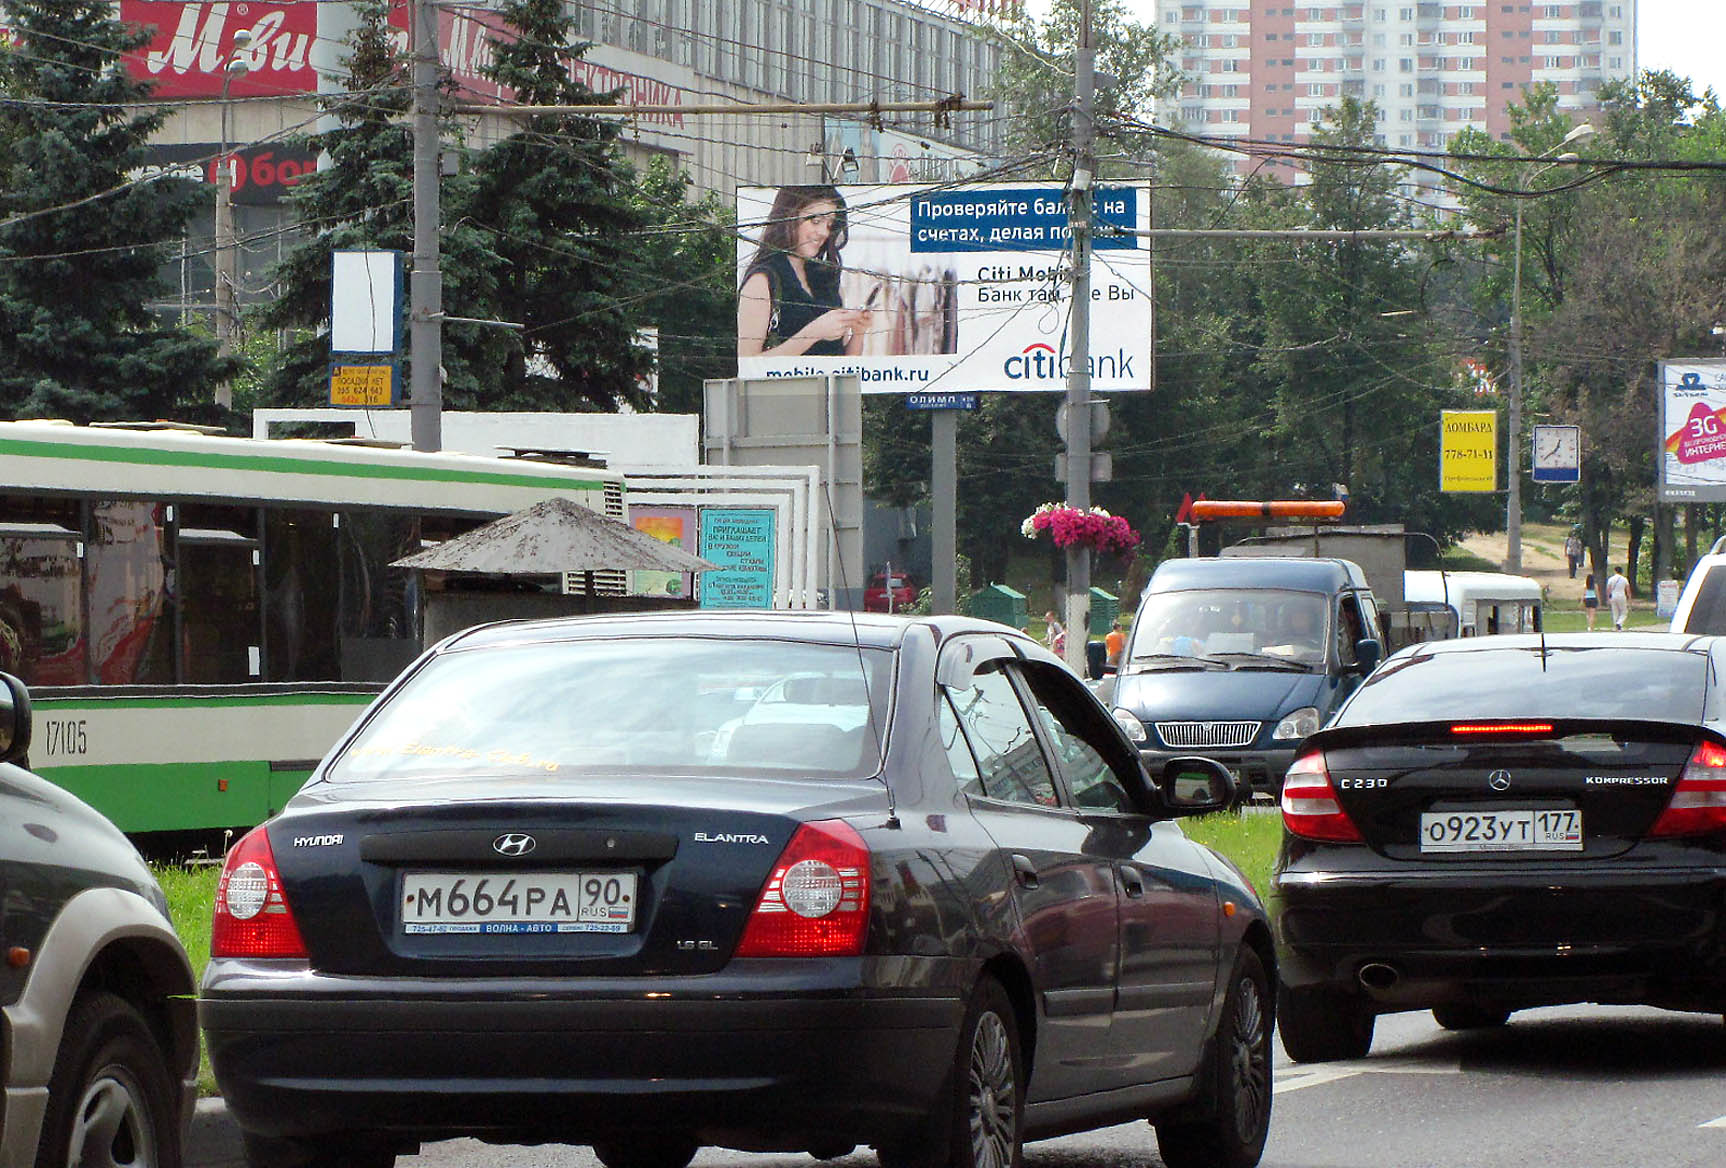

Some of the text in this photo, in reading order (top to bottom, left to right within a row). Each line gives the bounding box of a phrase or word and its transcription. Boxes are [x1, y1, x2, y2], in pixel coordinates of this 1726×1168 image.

[918, 198, 1125, 219] Проверяйте балс на
[918, 227, 984, 242] счетах,
[989, 227, 1044, 243] делая
[978, 266, 1011, 282] Citi
[978, 288, 1022, 303] Банк
[1108, 285, 1135, 301] Вы
[1445, 422, 1493, 433] ЛОМБАРД
[1689, 416, 1719, 437] 3G
[46, 720, 86, 755] 17105
[1341, 778, 1388, 789] C 230
[1586, 776, 1668, 785] KOMPRESSOR
[1538, 813, 1575, 832] 177
[294, 834, 344, 847] HYUNDAI
[694, 832, 769, 845] ELANTRA
[417, 878, 621, 917] М664РА 90
[581, 907, 606, 917] RUS
